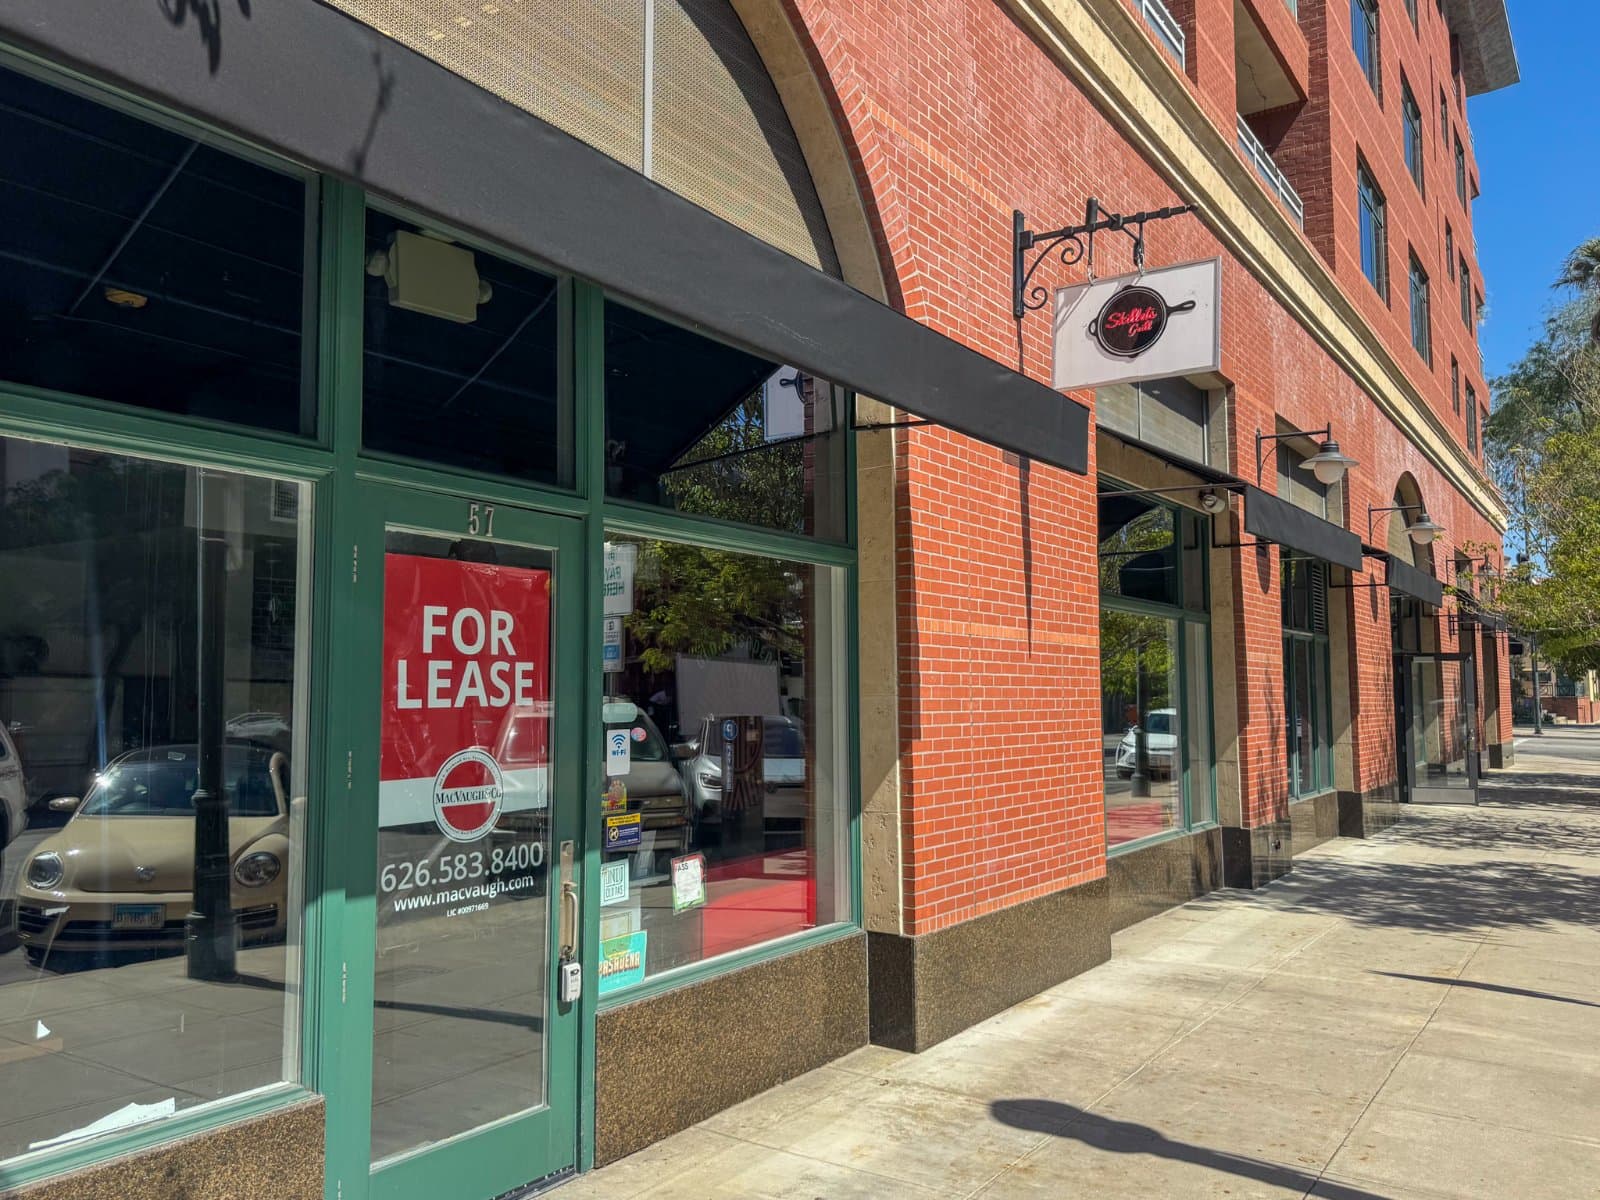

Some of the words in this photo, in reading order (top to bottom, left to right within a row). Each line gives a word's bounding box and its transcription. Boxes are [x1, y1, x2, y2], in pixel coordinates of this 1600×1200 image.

[1128, 320, 1153, 337] Grill
[468, 502, 496, 538] 57
[422, 605, 517, 657] FOR
[397, 659, 534, 710] LEASE
[380, 841, 544, 893] 626.583.8400
[394, 874, 534, 912] www.macvaugh.com
[446, 908, 457, 918] LIC
